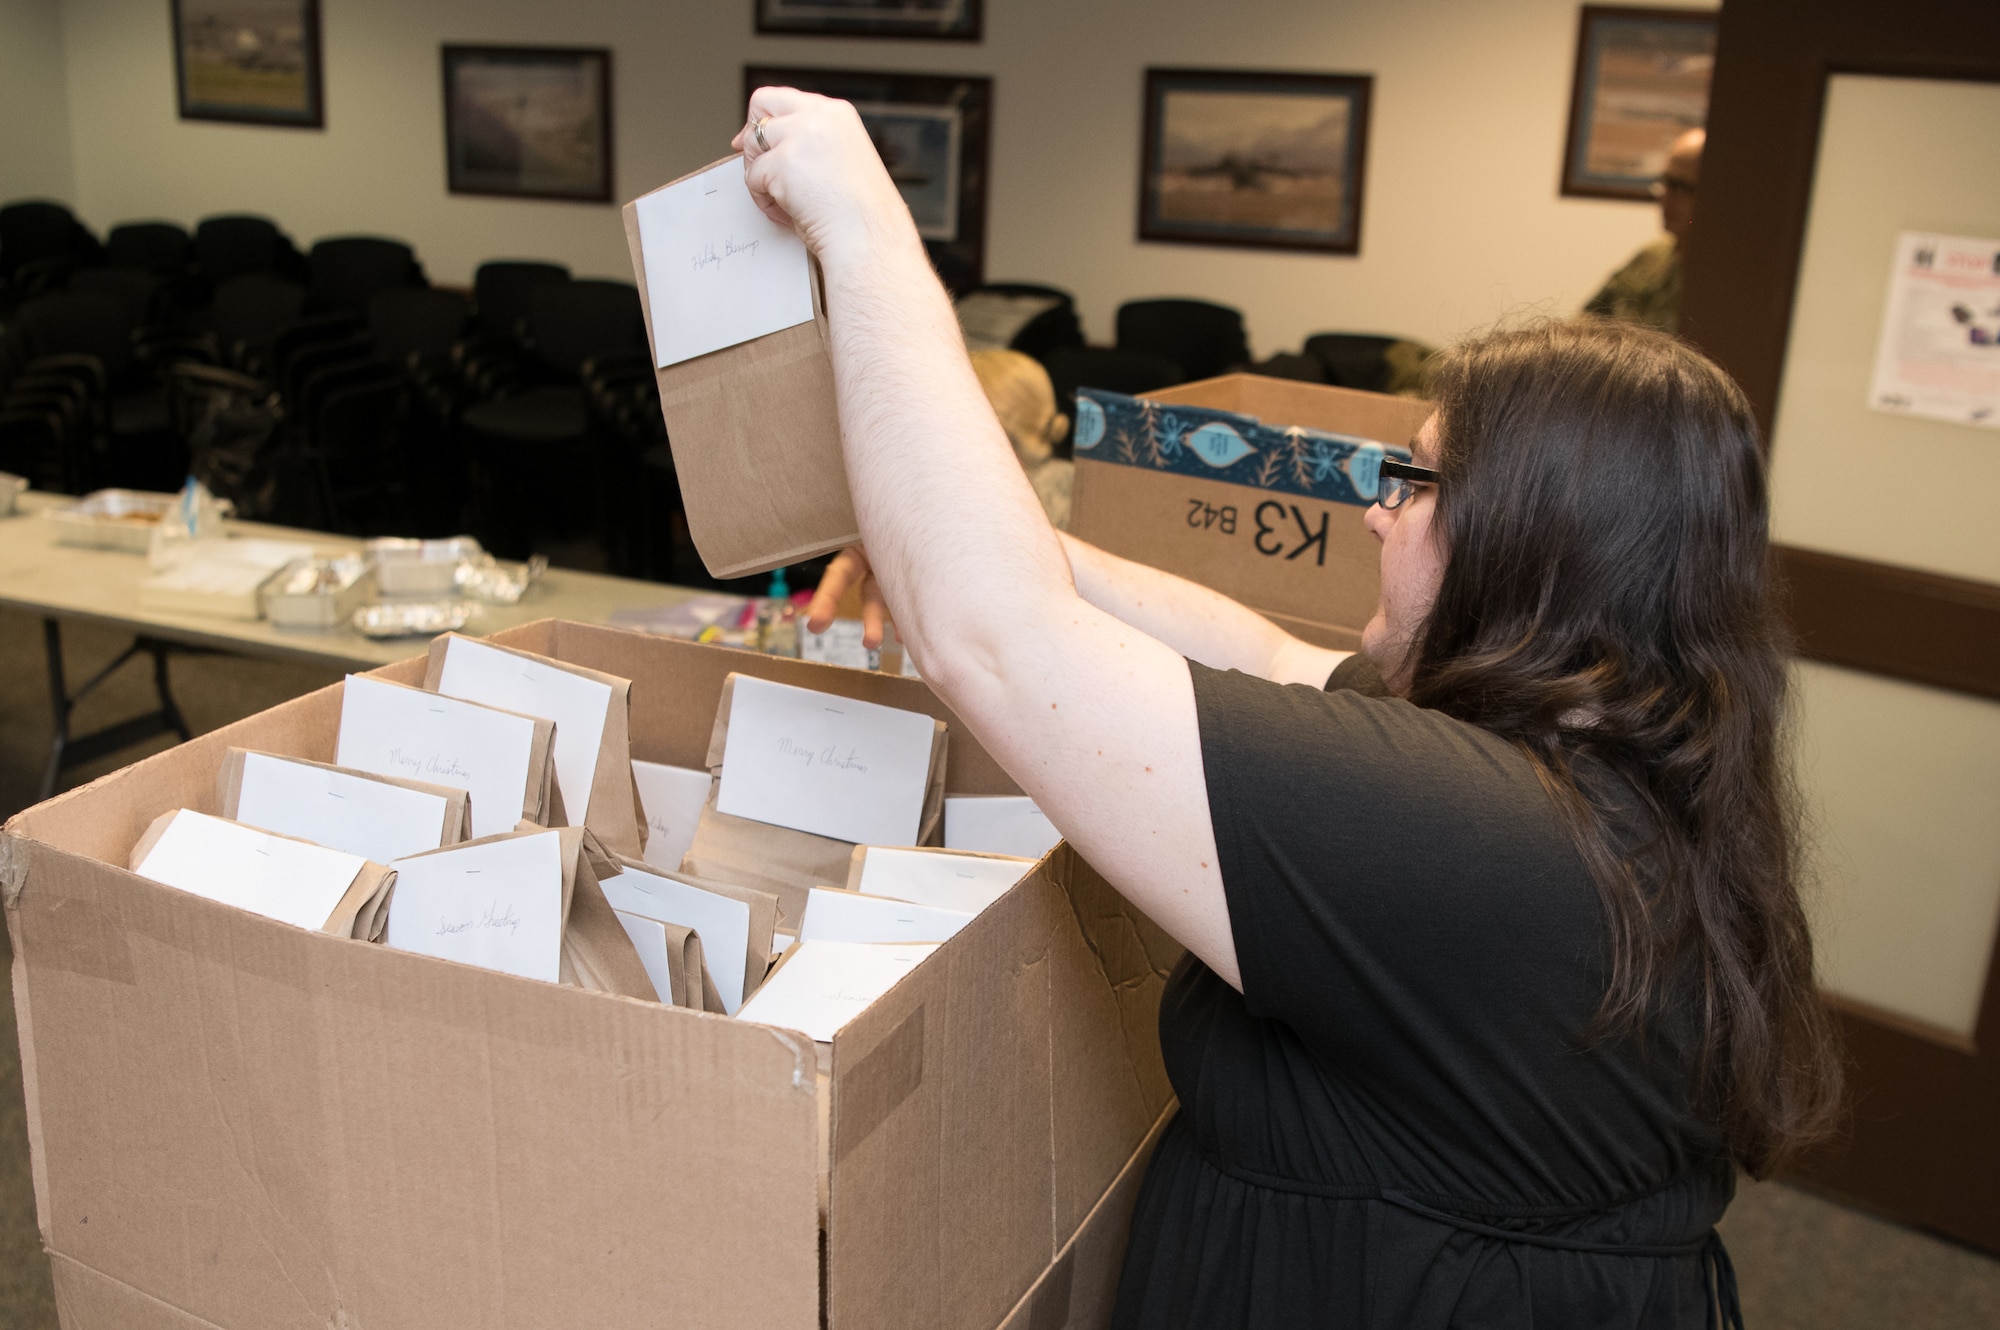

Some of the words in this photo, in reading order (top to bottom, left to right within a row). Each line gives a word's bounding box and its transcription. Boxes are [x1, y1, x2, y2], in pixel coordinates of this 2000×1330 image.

[1186, 498, 1238, 536] B42
[1254, 499, 1330, 567] K3
[388, 747, 422, 776] Merry
[425, 752, 471, 781] Christmas
[777, 736, 814, 767] Merry
[819, 744, 868, 774] Christmas
